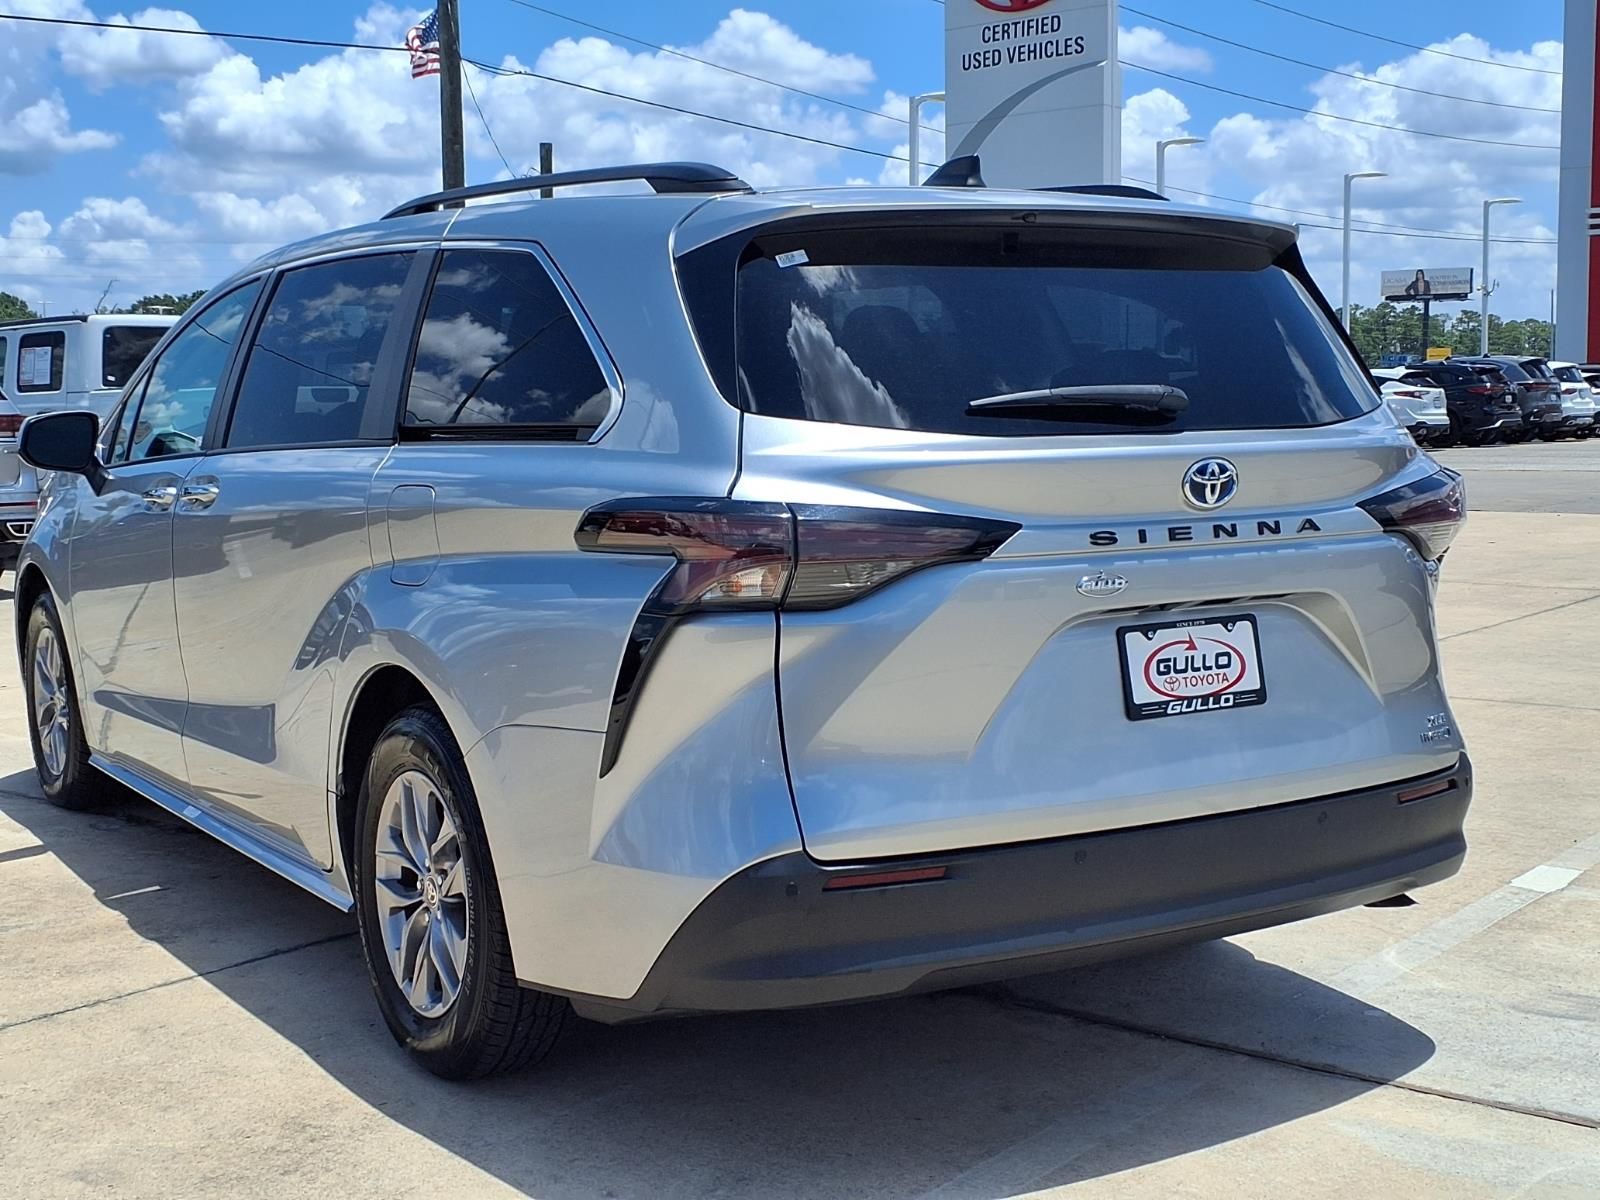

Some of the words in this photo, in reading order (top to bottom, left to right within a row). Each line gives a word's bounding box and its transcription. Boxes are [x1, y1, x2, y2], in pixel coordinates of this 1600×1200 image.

[982, 15, 1061, 43] CERTIFIED
[962, 49, 1001, 71] USED
[1006, 36, 1085, 64] VEHICLES
[1089, 518, 1321, 546] SIENNA
[1156, 651, 1232, 676] GULLO
[1183, 672, 1230, 688] TOYOTA
[1166, 694, 1234, 714] GULLO
